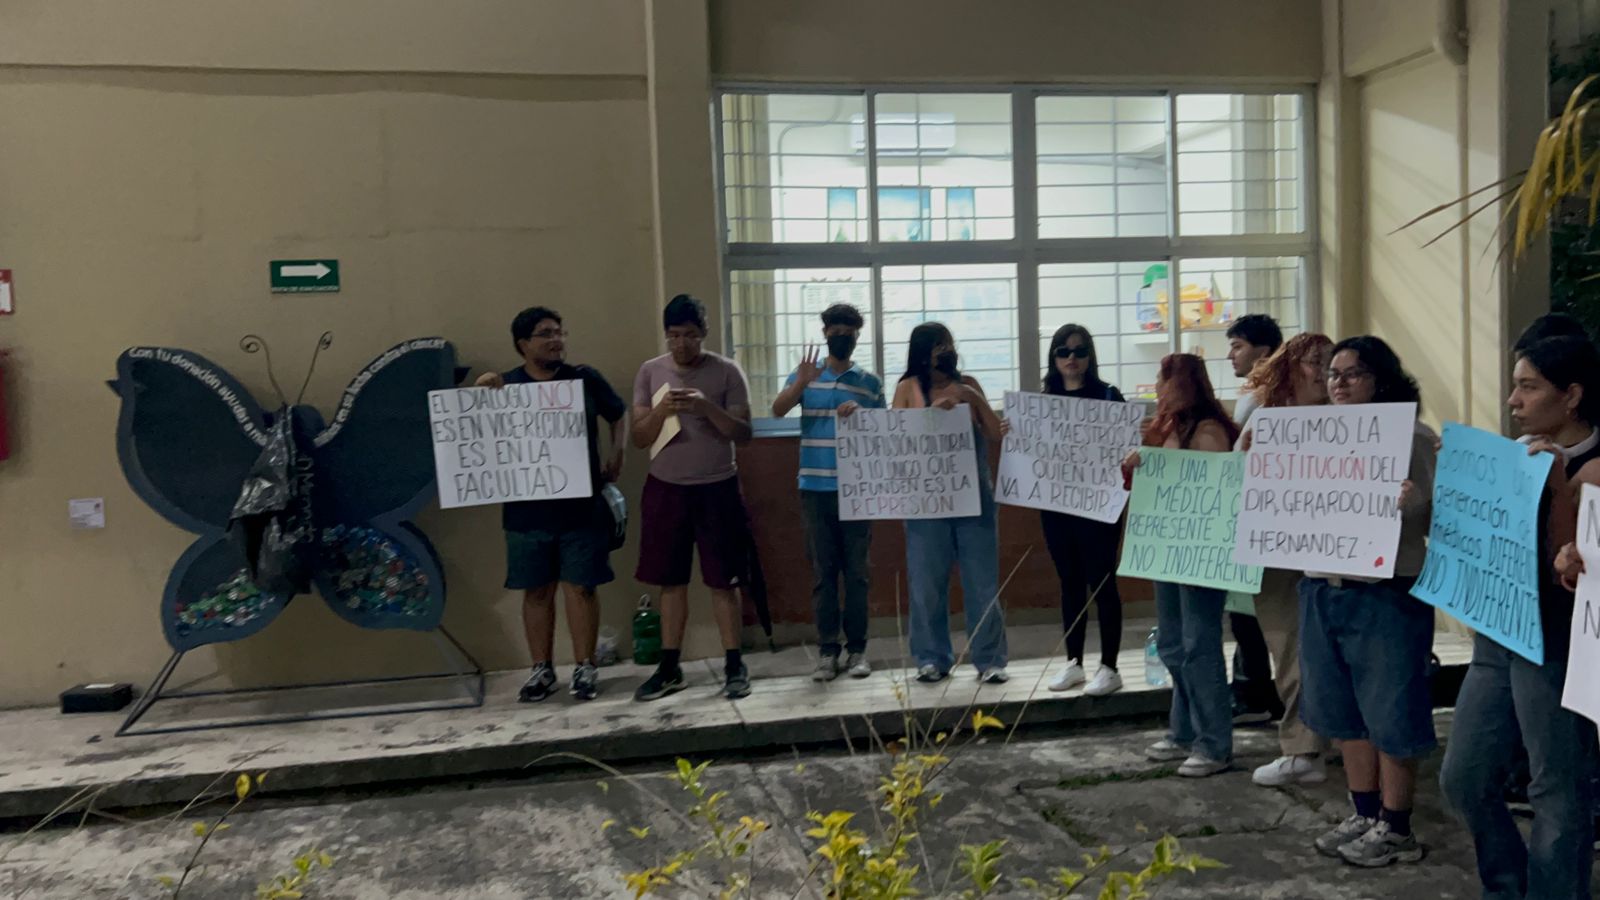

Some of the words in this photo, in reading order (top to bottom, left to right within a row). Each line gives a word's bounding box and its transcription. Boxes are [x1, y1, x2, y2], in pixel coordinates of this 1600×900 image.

[129, 347, 153, 359] Con
[431, 394, 450, 414] EL
[457, 382, 532, 414] DIALOGO
[537, 380, 574, 410] NO
[1005, 391, 1070, 422] PUEDEN
[1076, 399, 1140, 425] OBLIGAR
[433, 418, 457, 443] ES
[458, 415, 484, 441] EN
[886, 409, 907, 432] DE
[1018, 417, 1042, 440] LOS
[1051, 421, 1125, 448] MAESTROS
[1128, 430, 1139, 447] A
[1255, 416, 1350, 451] EXIGIMOS
[1357, 415, 1381, 444] LA
[458, 441, 486, 469] ES
[495, 439, 523, 465] EN
[528, 440, 551, 465] LA
[838, 436, 858, 459] EN
[1005, 436, 1031, 454] DAR
[852, 461, 863, 481] Y
[868, 459, 883, 480] LO
[927, 454, 959, 475] QUE
[1032, 459, 1085, 482] QUIEN
[1092, 466, 1117, 487] LAS
[1179, 458, 1208, 483] UNA
[1250, 450, 1365, 481] DESTITUCIÓN
[1370, 454, 1402, 483] DEL
[454, 465, 569, 503] FACULTAD
[842, 479, 918, 498] DIFUNDEN
[924, 477, 946, 493] ES
[952, 475, 971, 492] LA
[1000, 475, 1020, 498] VA
[1028, 481, 1042, 500] A
[1154, 480, 1222, 516] MÉDICA
[1283, 489, 1364, 520] GERARDO
[1128, 512, 1215, 541] REPRESENTE
[1129, 544, 1156, 573] NO
